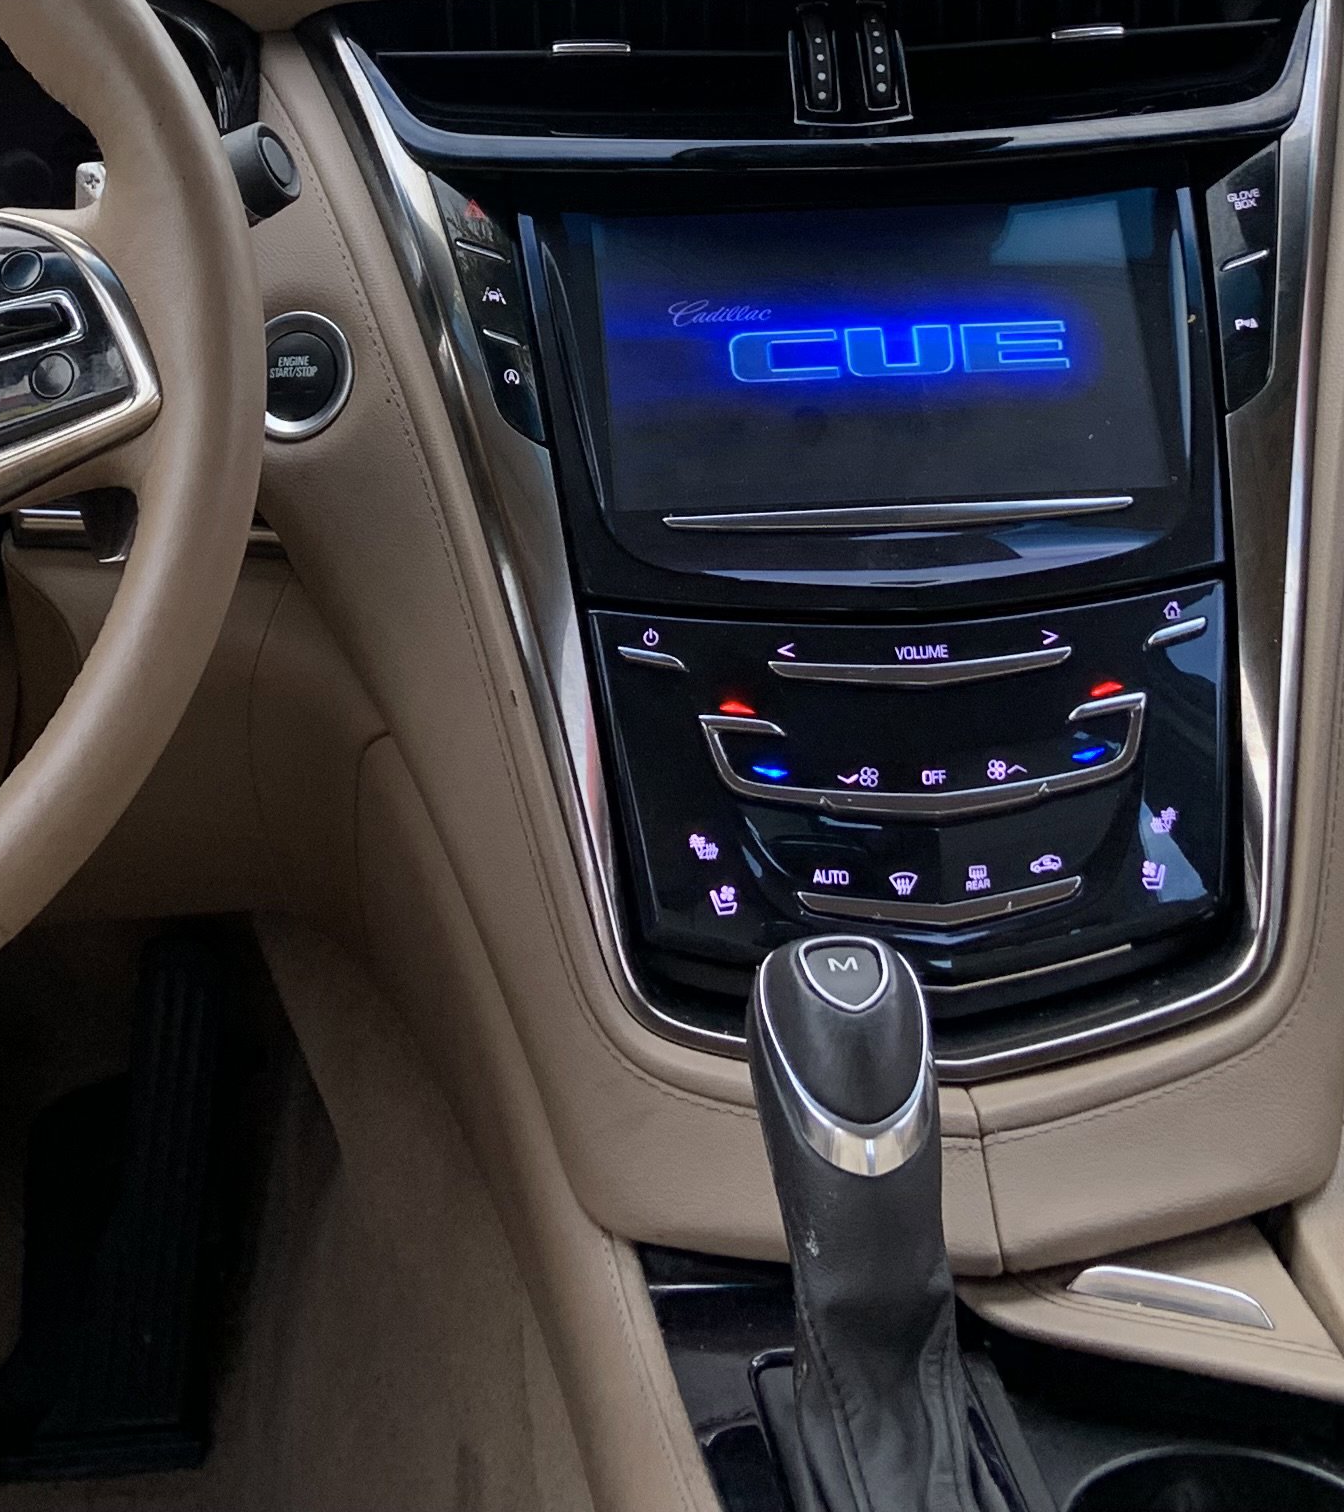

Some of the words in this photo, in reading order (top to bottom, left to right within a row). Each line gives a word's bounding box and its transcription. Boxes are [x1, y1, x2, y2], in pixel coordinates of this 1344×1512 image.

[1226, 187, 1260, 203] GLOVE
[1234, 198, 1258, 210] BOX
[668, 299, 772, 328] Cadillac
[729, 320, 1071, 383] CUE
[278, 355, 310, 367] ENGINE
[269, 365, 319, 378] START/STOP
[894, 644, 949, 660] VOLUME
[921, 769, 947, 786] OFF
[812, 868, 850, 886] AUTO
[965, 877, 991, 892] REAR
[826, 956, 859, 973] M
